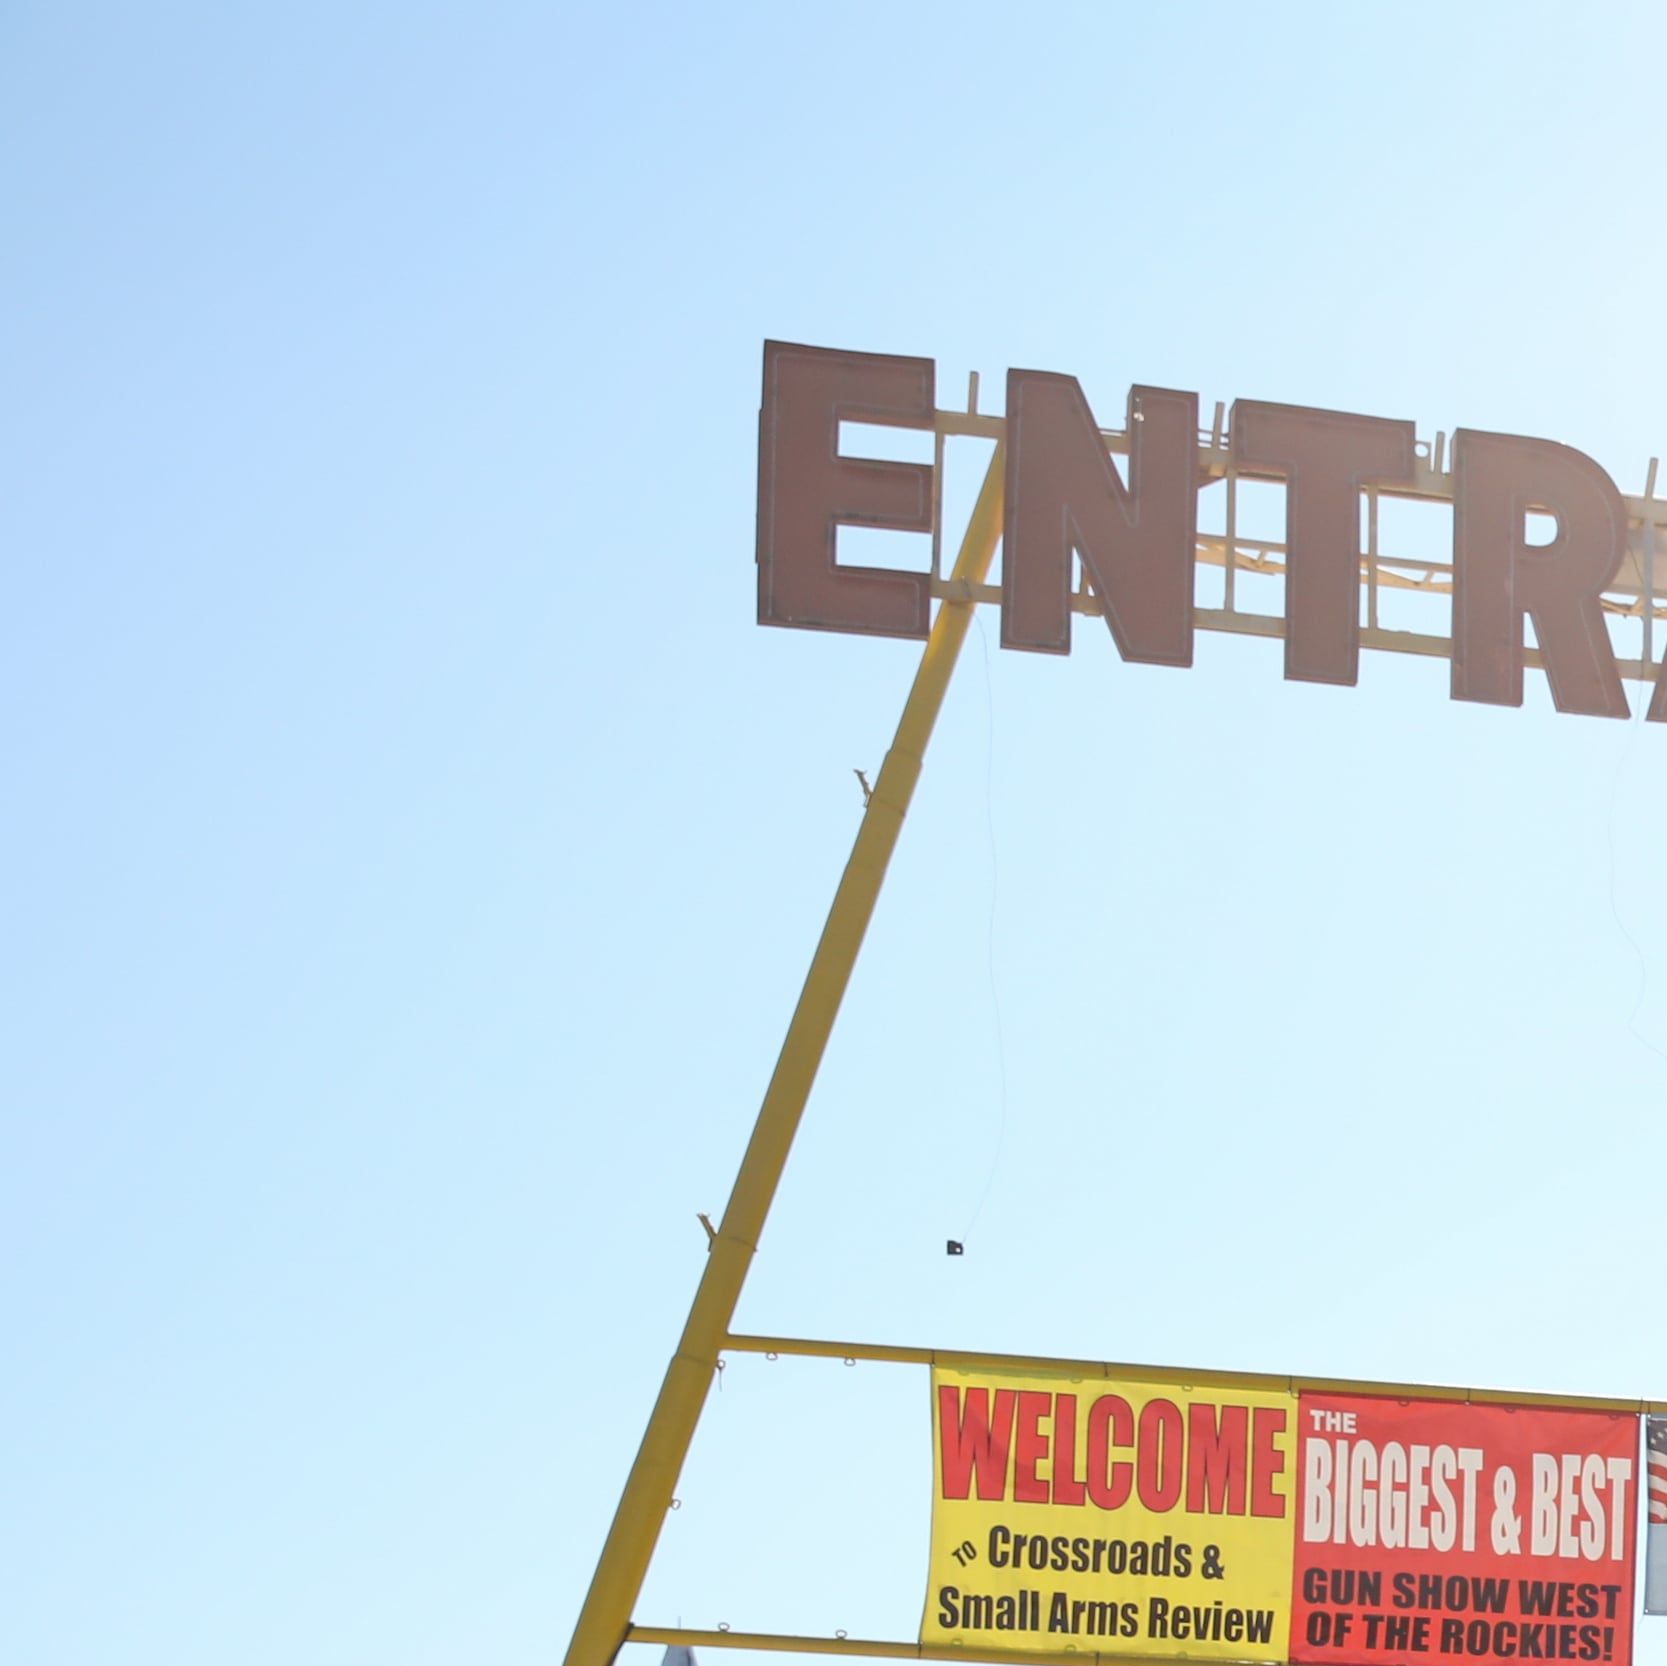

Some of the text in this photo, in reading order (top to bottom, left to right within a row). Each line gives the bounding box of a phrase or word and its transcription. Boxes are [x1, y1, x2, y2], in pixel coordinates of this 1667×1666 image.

[1310, 1409, 1357, 1435] THE
[938, 1386, 1287, 1518] WELCOME
[1304, 1438, 1632, 1561] BIGGEST & BEST
[951, 1525, 1225, 1580] TO Crossroads &
[938, 1586, 1274, 1645] Small Arms Review
[1303, 1567, 1622, 1619] GUN SHOW WEST
[1306, 1610, 1613, 1662] OF THE ROCKIES!
